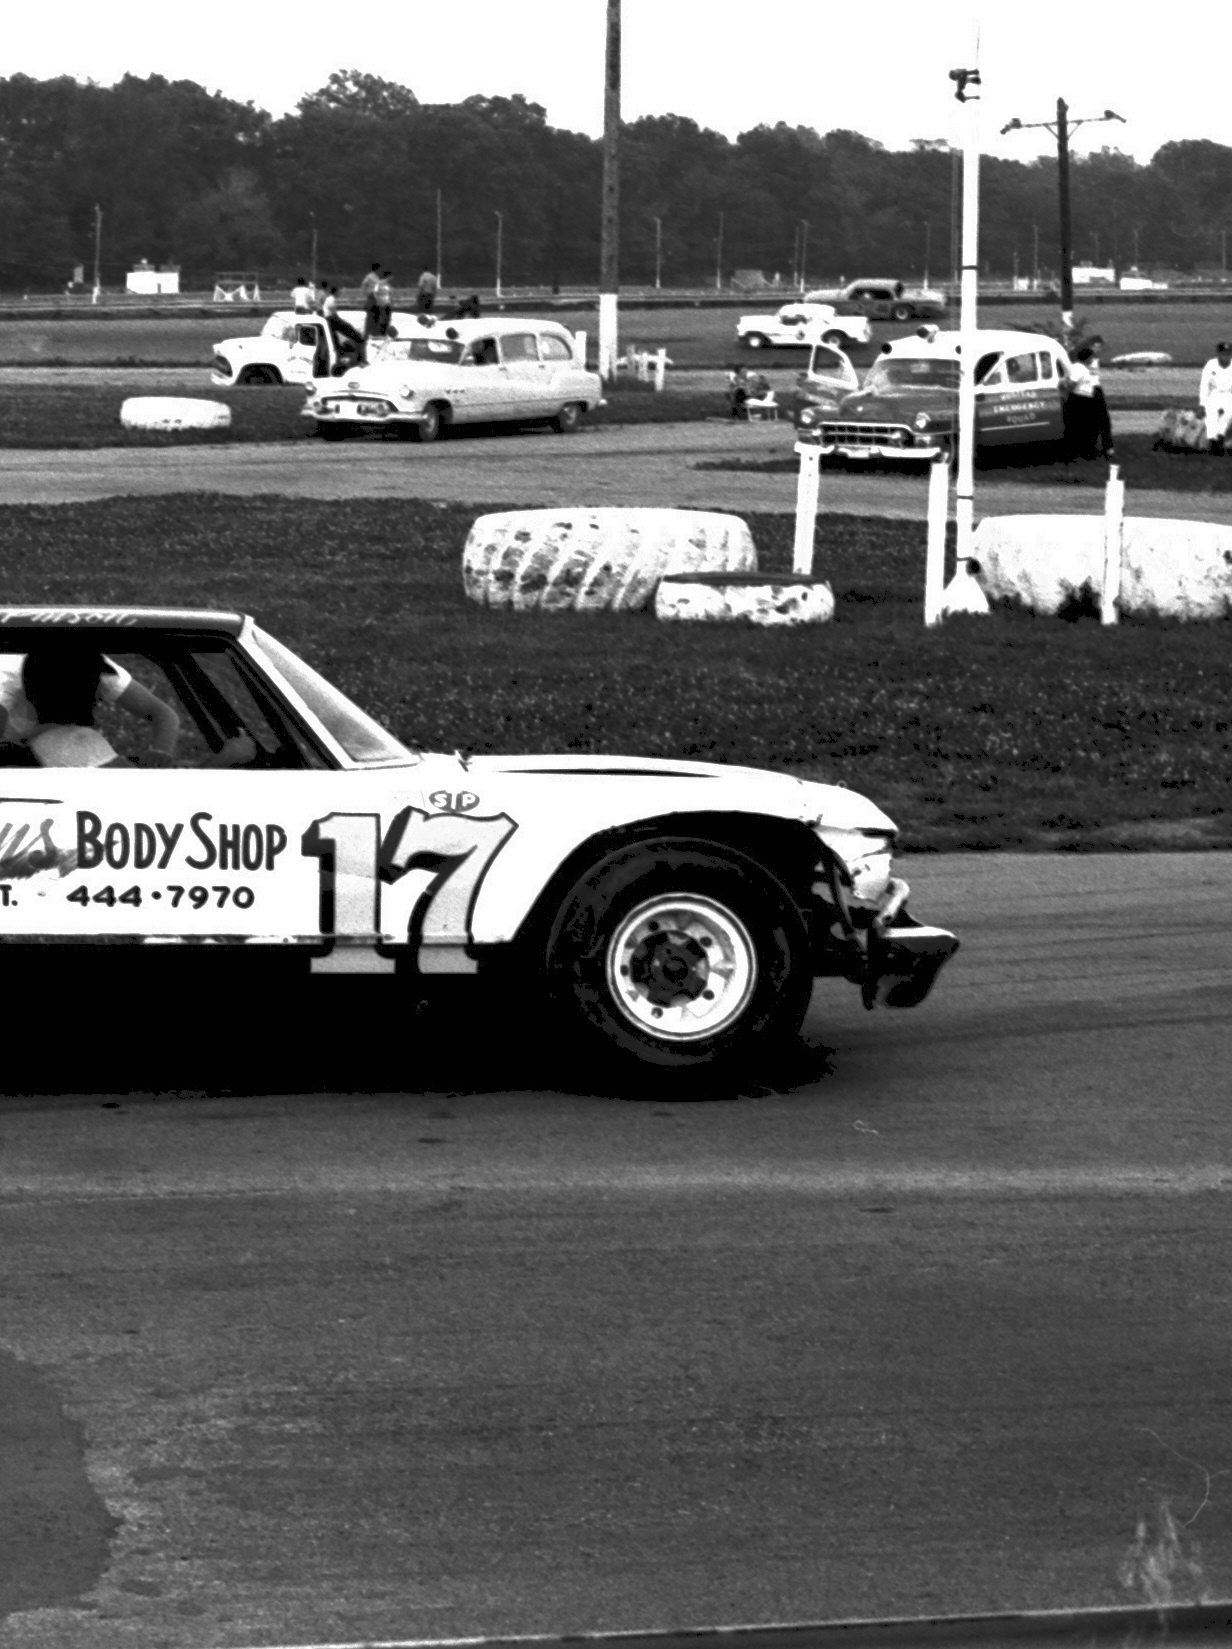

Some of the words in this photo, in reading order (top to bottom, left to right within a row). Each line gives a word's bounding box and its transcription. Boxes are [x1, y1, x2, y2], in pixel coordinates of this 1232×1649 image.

[429, 789, 480, 812] STP
[76, 810, 184, 870] BODY
[185, 811, 287, 871] SHOP
[301, 805, 519, 975] 17
